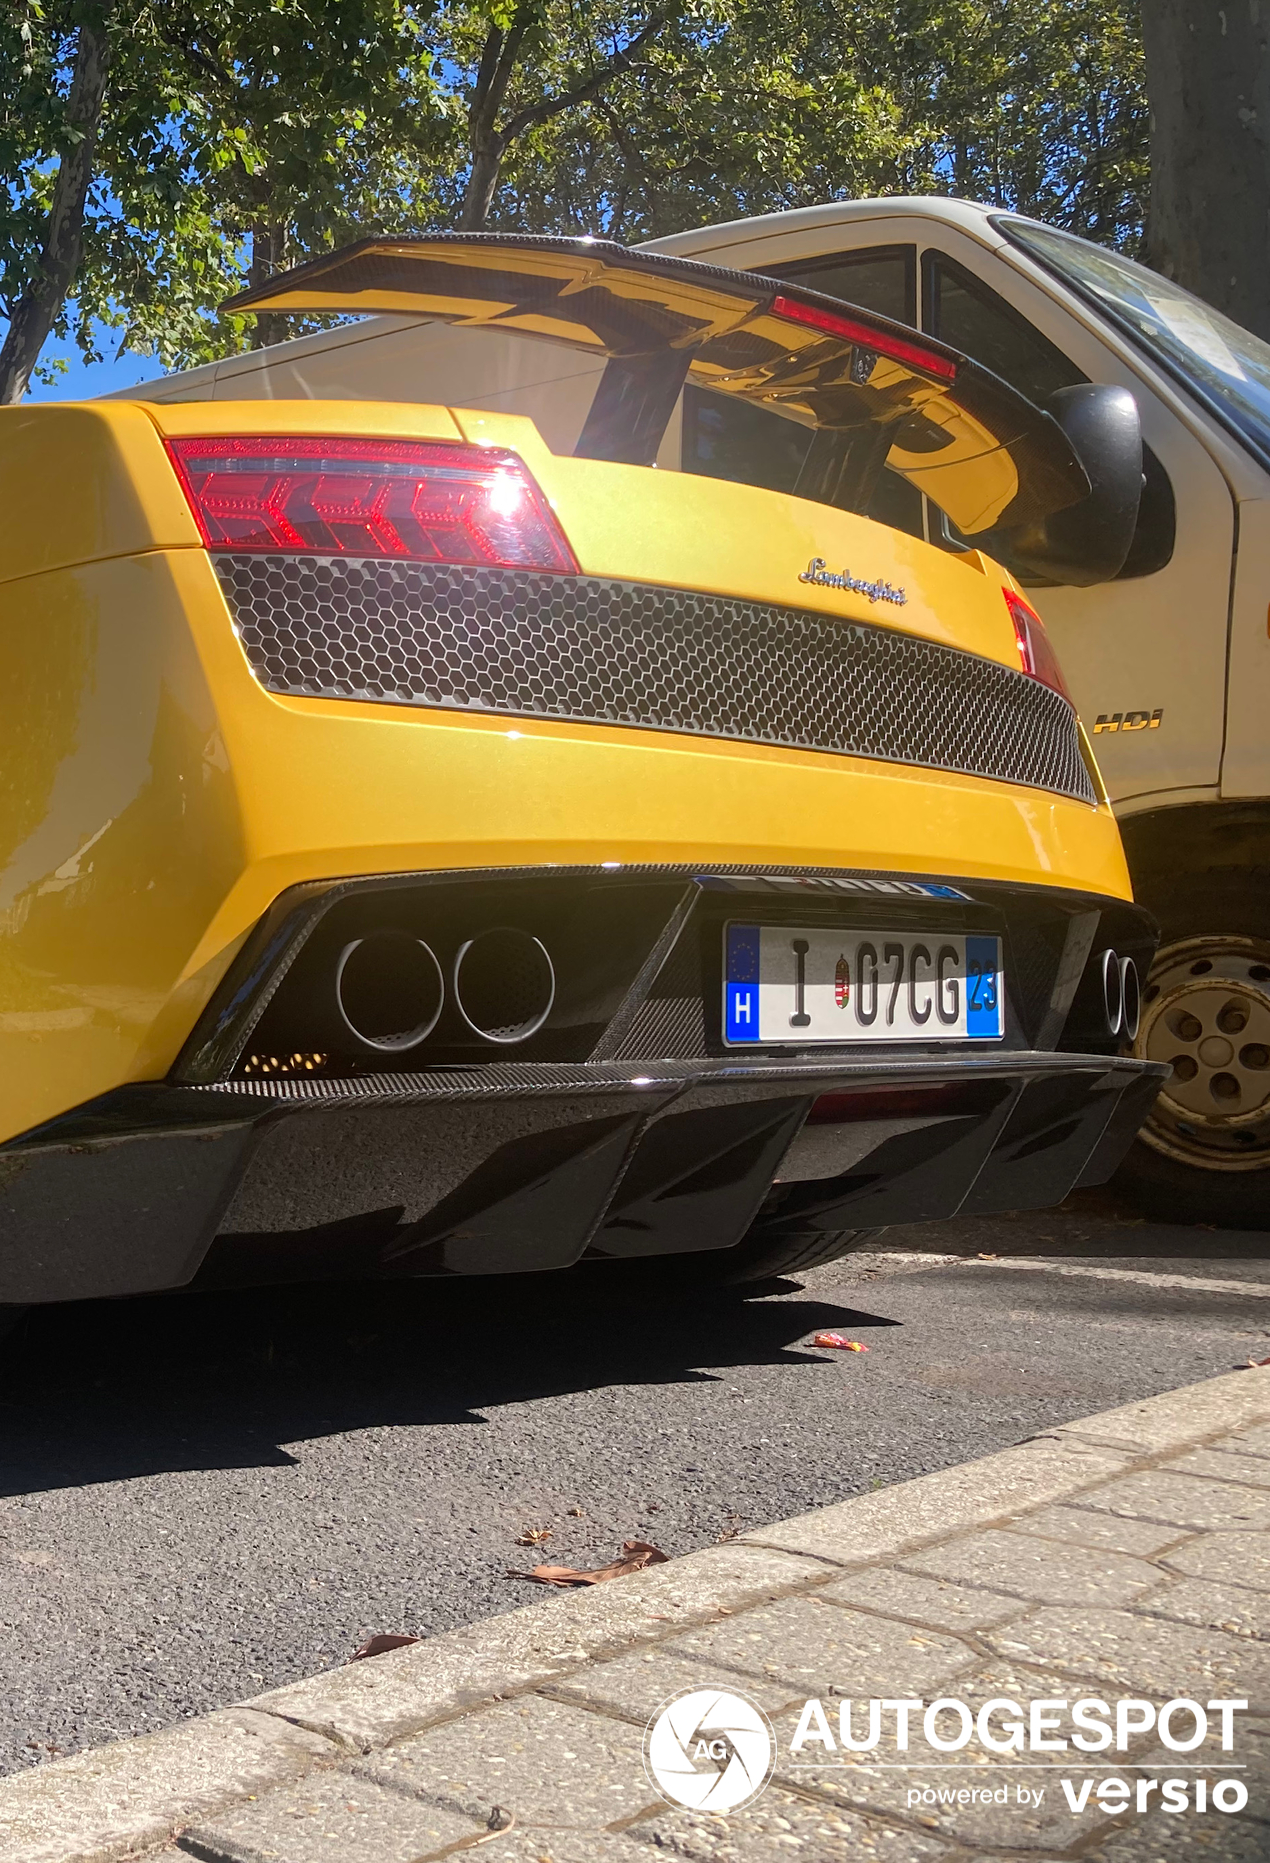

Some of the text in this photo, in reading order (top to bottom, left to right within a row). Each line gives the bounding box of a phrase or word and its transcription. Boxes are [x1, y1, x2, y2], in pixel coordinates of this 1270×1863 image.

[798, 557, 908, 607] Lamborghini
[790, 938, 811, 1027] I
[968, 958, 998, 1012] 23
[734, 991, 751, 1025] H
